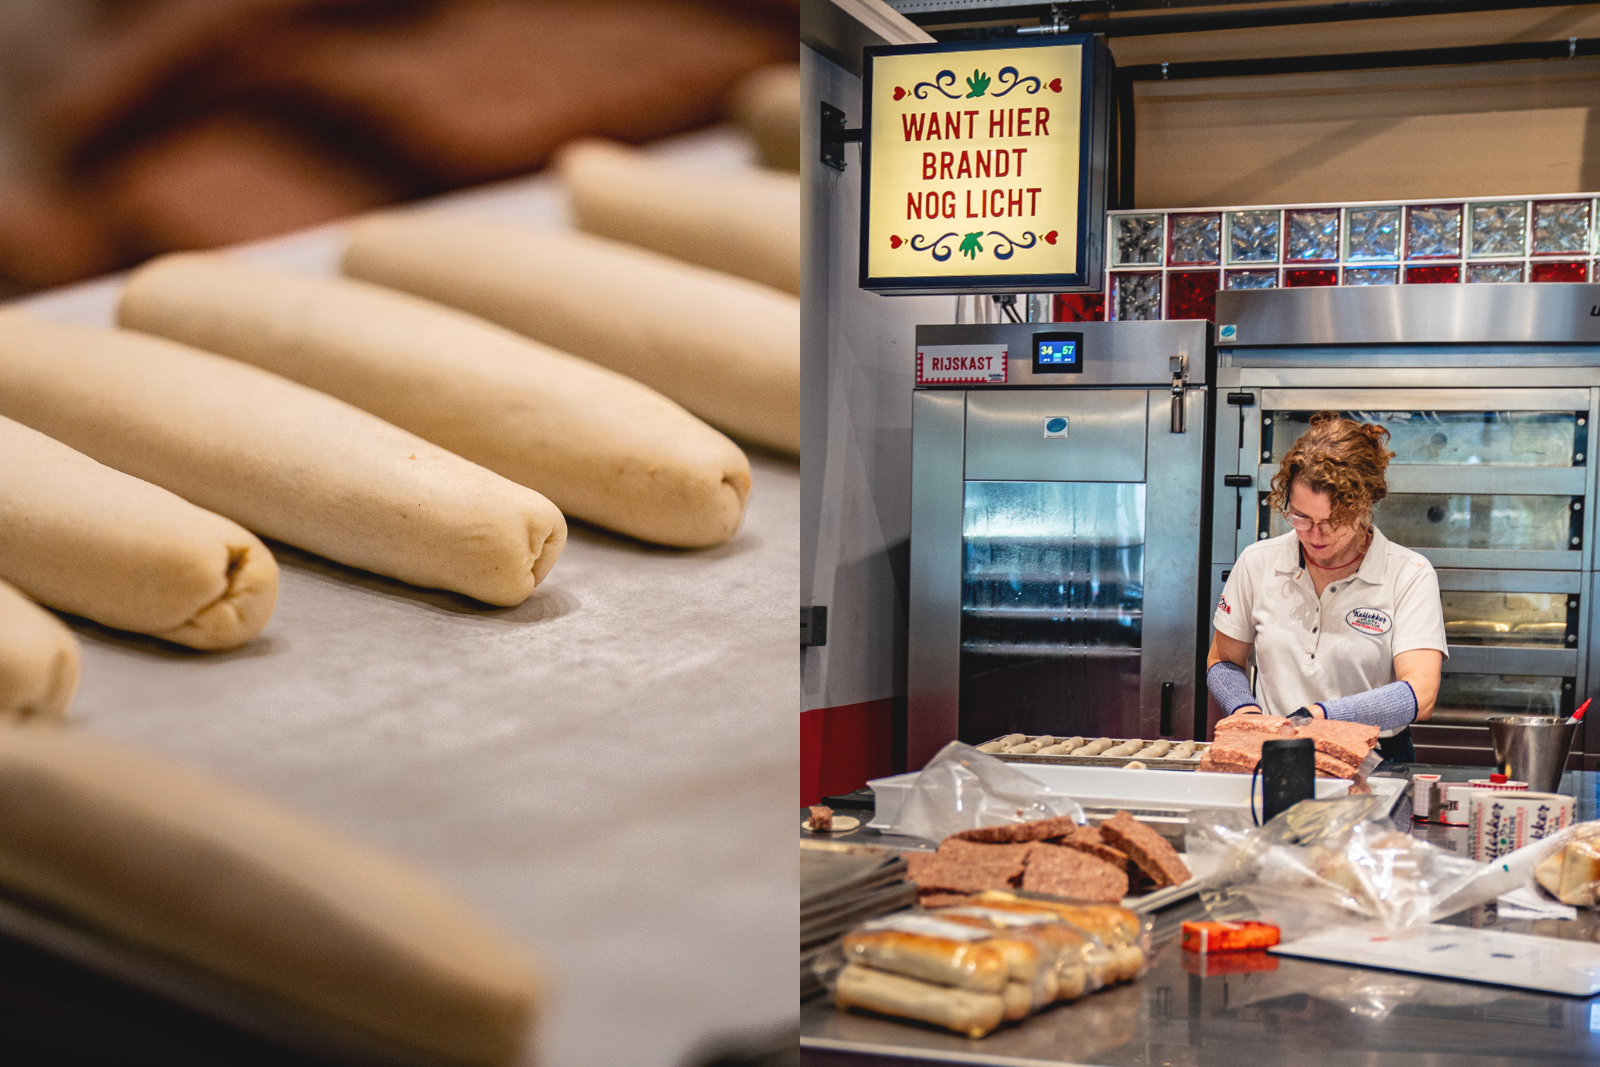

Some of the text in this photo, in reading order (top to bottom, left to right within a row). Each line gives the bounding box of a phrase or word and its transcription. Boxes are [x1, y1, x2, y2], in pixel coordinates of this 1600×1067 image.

[901, 107, 1051, 142] WANT HIER
[922, 148, 1028, 181] BRANDT
[906, 187, 1042, 220] NOG LICHT
[931, 356, 994, 371] RIJSKAST
[1040, 345, 1074, 355] 34 57
[1485, 802, 1504, 864] ilekker
